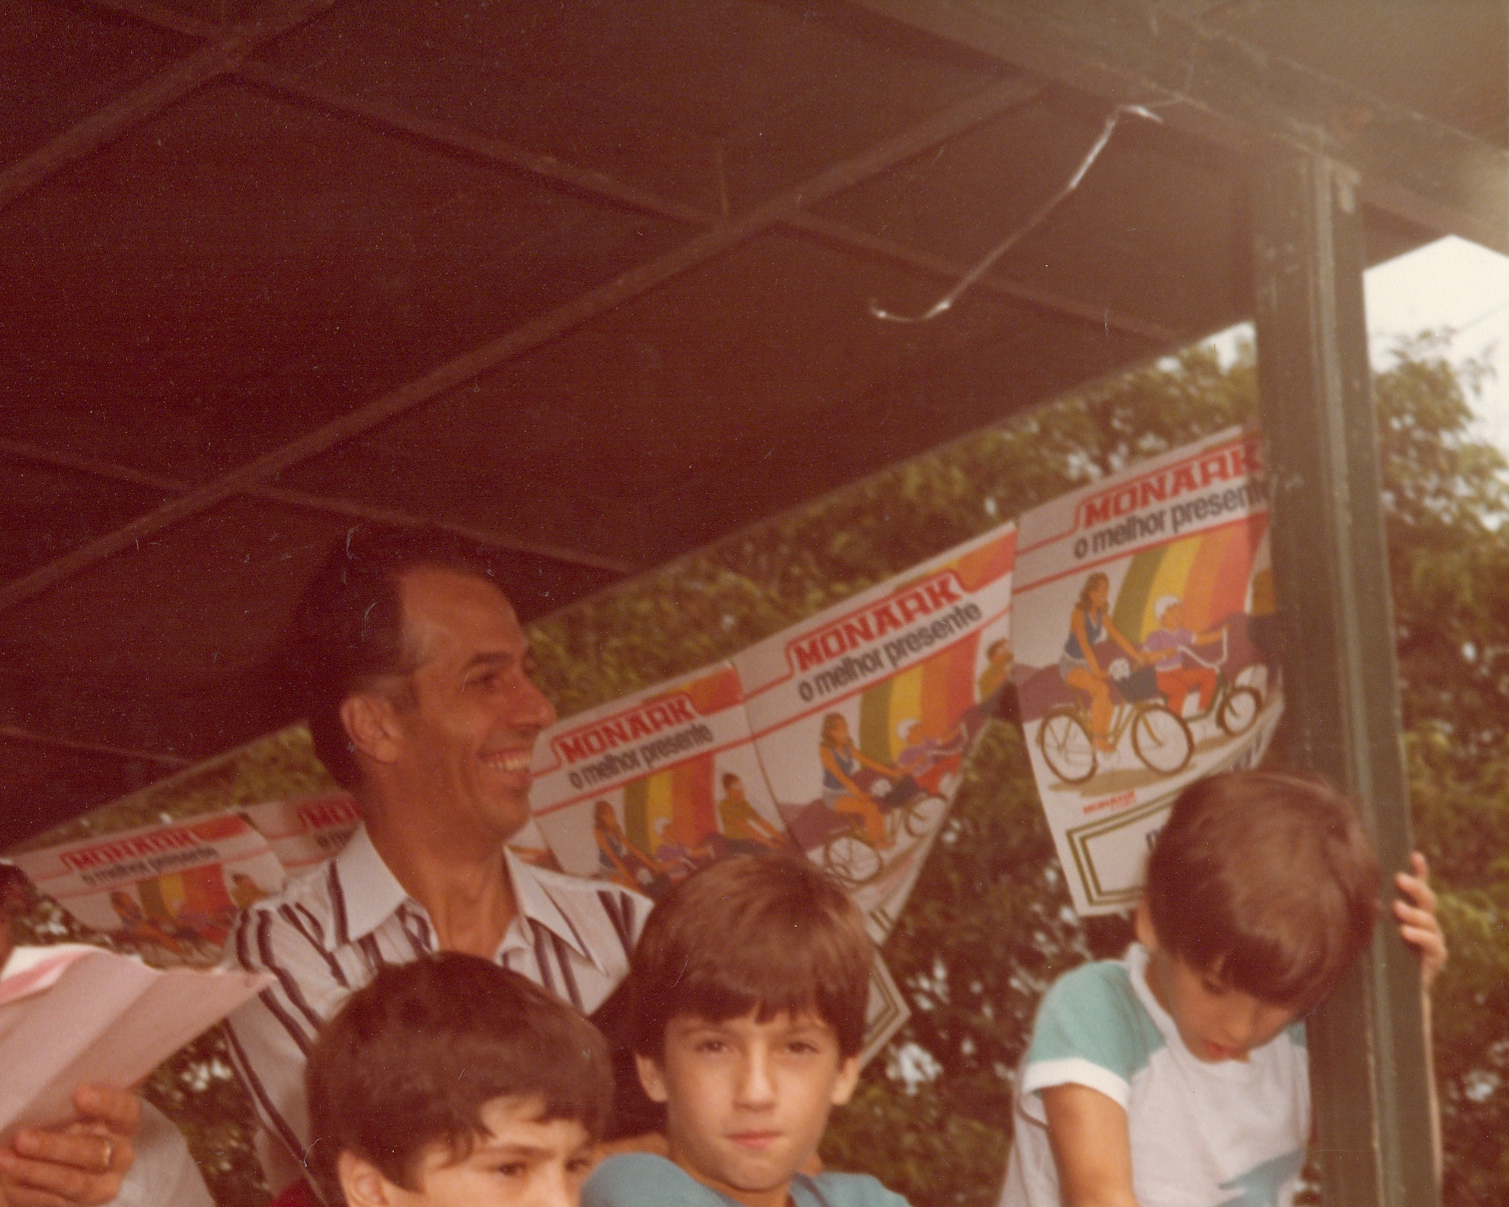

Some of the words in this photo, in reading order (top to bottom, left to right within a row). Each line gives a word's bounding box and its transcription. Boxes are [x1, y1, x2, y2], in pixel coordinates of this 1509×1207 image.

[1084, 445, 1264, 528] MONARK
[1074, 538, 1088, 560] o
[1092, 509, 1166, 554] melhor
[794, 575, 961, 671] MONARK
[798, 679, 814, 702] o
[814, 649, 885, 695] melhor
[884, 602, 982, 669] presente
[558, 701, 696, 764] MONARK
